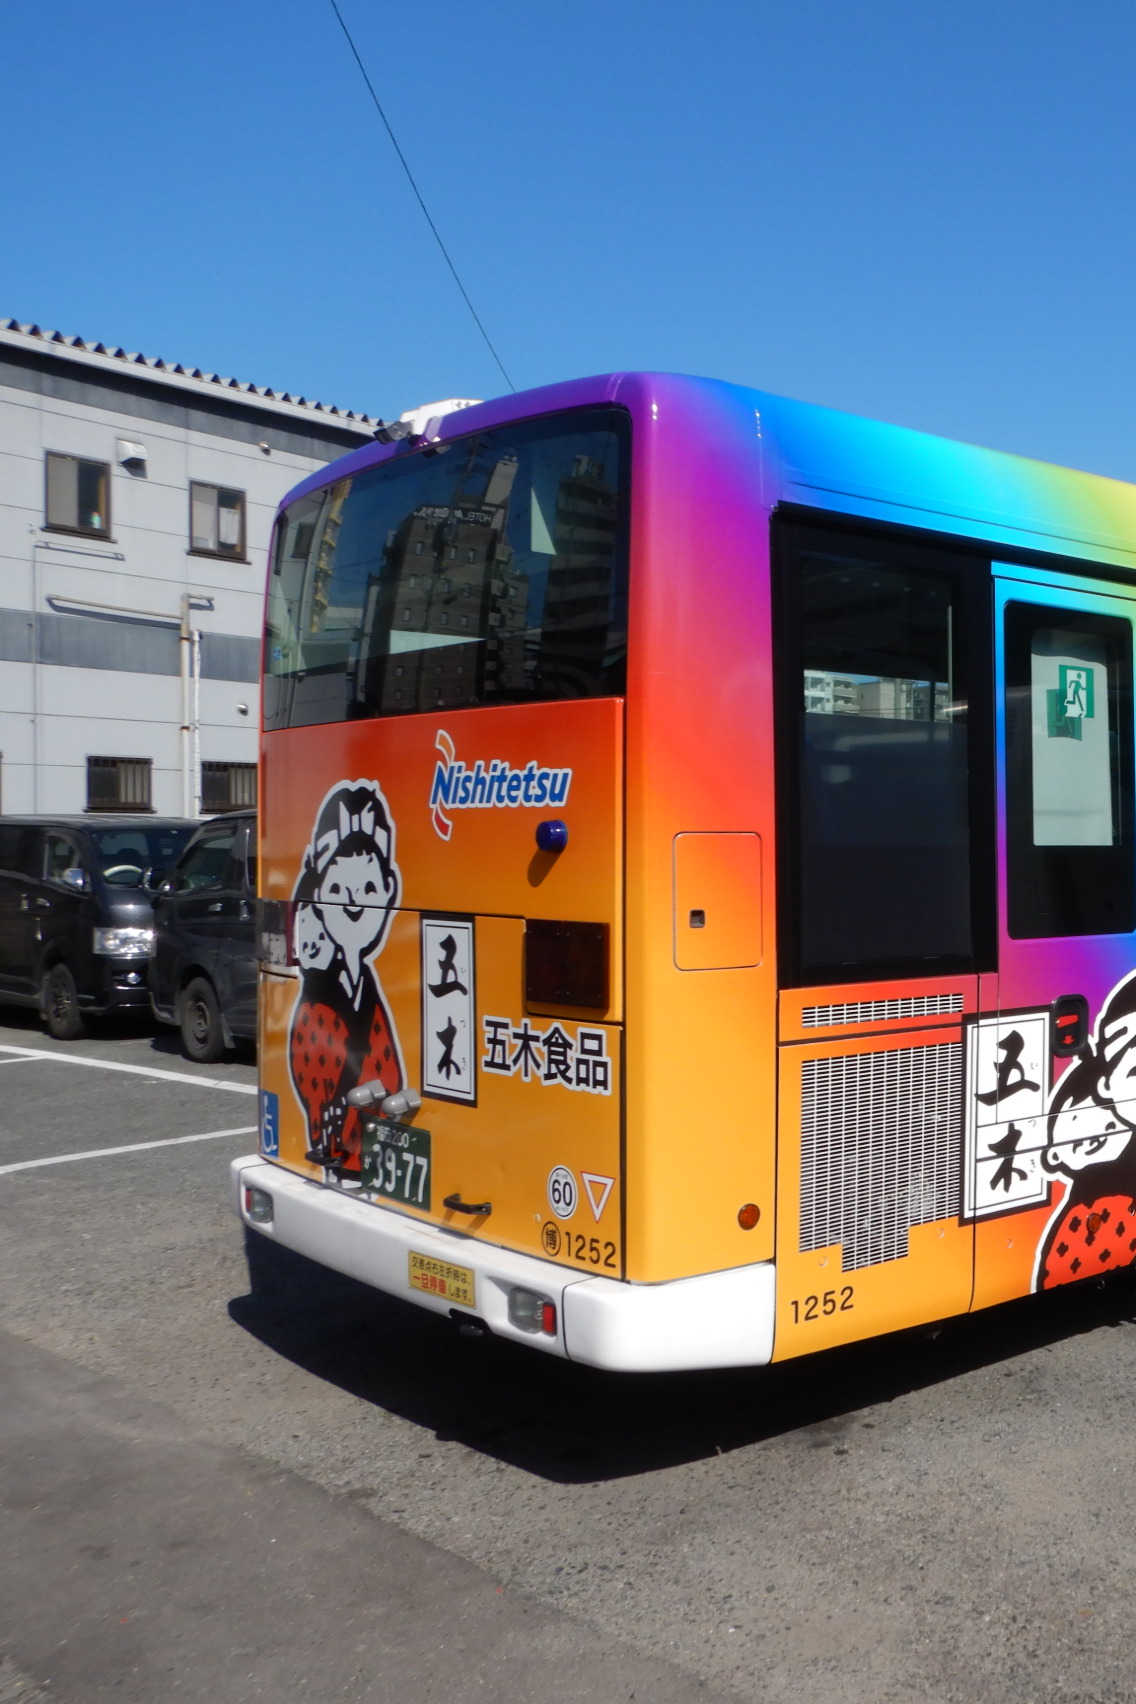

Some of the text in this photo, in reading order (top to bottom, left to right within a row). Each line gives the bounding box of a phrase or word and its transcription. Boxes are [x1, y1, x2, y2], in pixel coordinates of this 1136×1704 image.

[430, 761, 571, 807] Nishitetsu
[482, 1018, 610, 1092] 五木食品
[974, 1029, 1041, 1194] 五木
[372, 1143, 428, 1203] 39-77
[551, 1179, 573, 1207] 60
[564, 1231, 616, 1269] 1252
[790, 1285, 855, 1325] 1252
